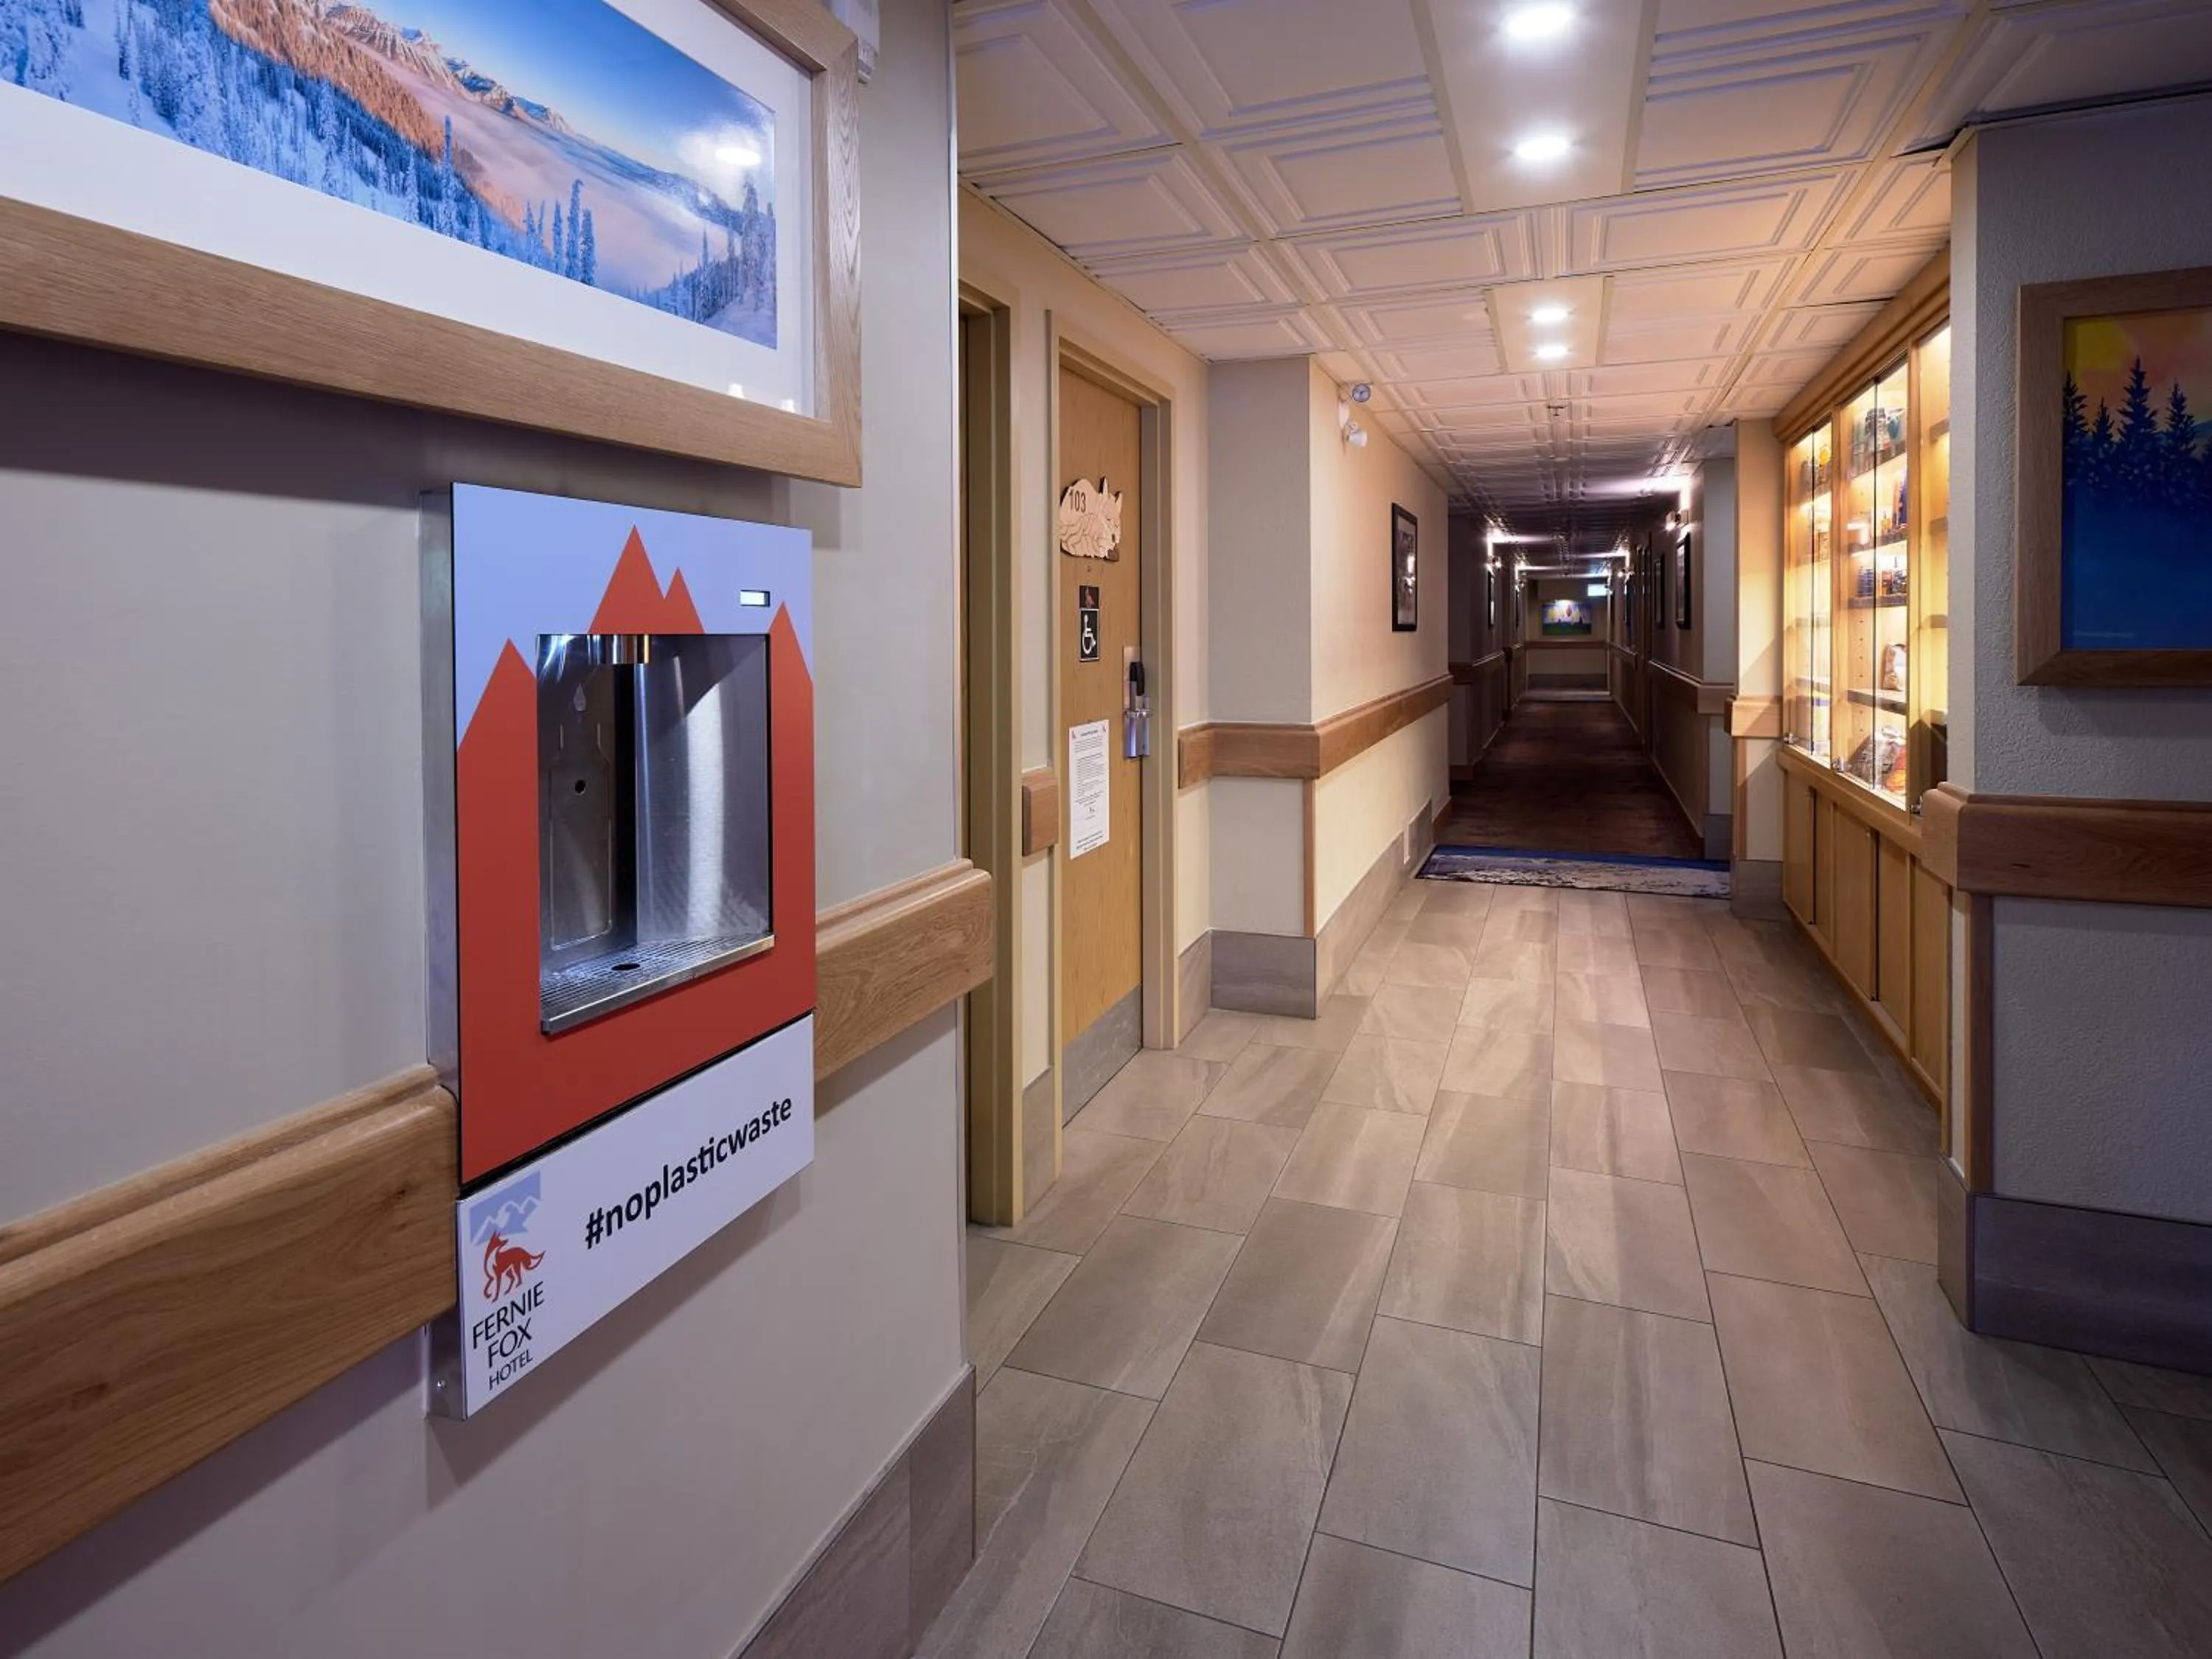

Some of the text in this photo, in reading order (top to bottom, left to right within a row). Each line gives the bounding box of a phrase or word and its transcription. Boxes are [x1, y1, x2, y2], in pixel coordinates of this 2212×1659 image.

[1069, 489, 1086, 512] 103
[585, 1098, 792, 1250] #noplasticwaste
[473, 1281, 545, 1349] FERNIE
[488, 1318, 532, 1368] FOX
[489, 1349, 532, 1391] HOTEL
